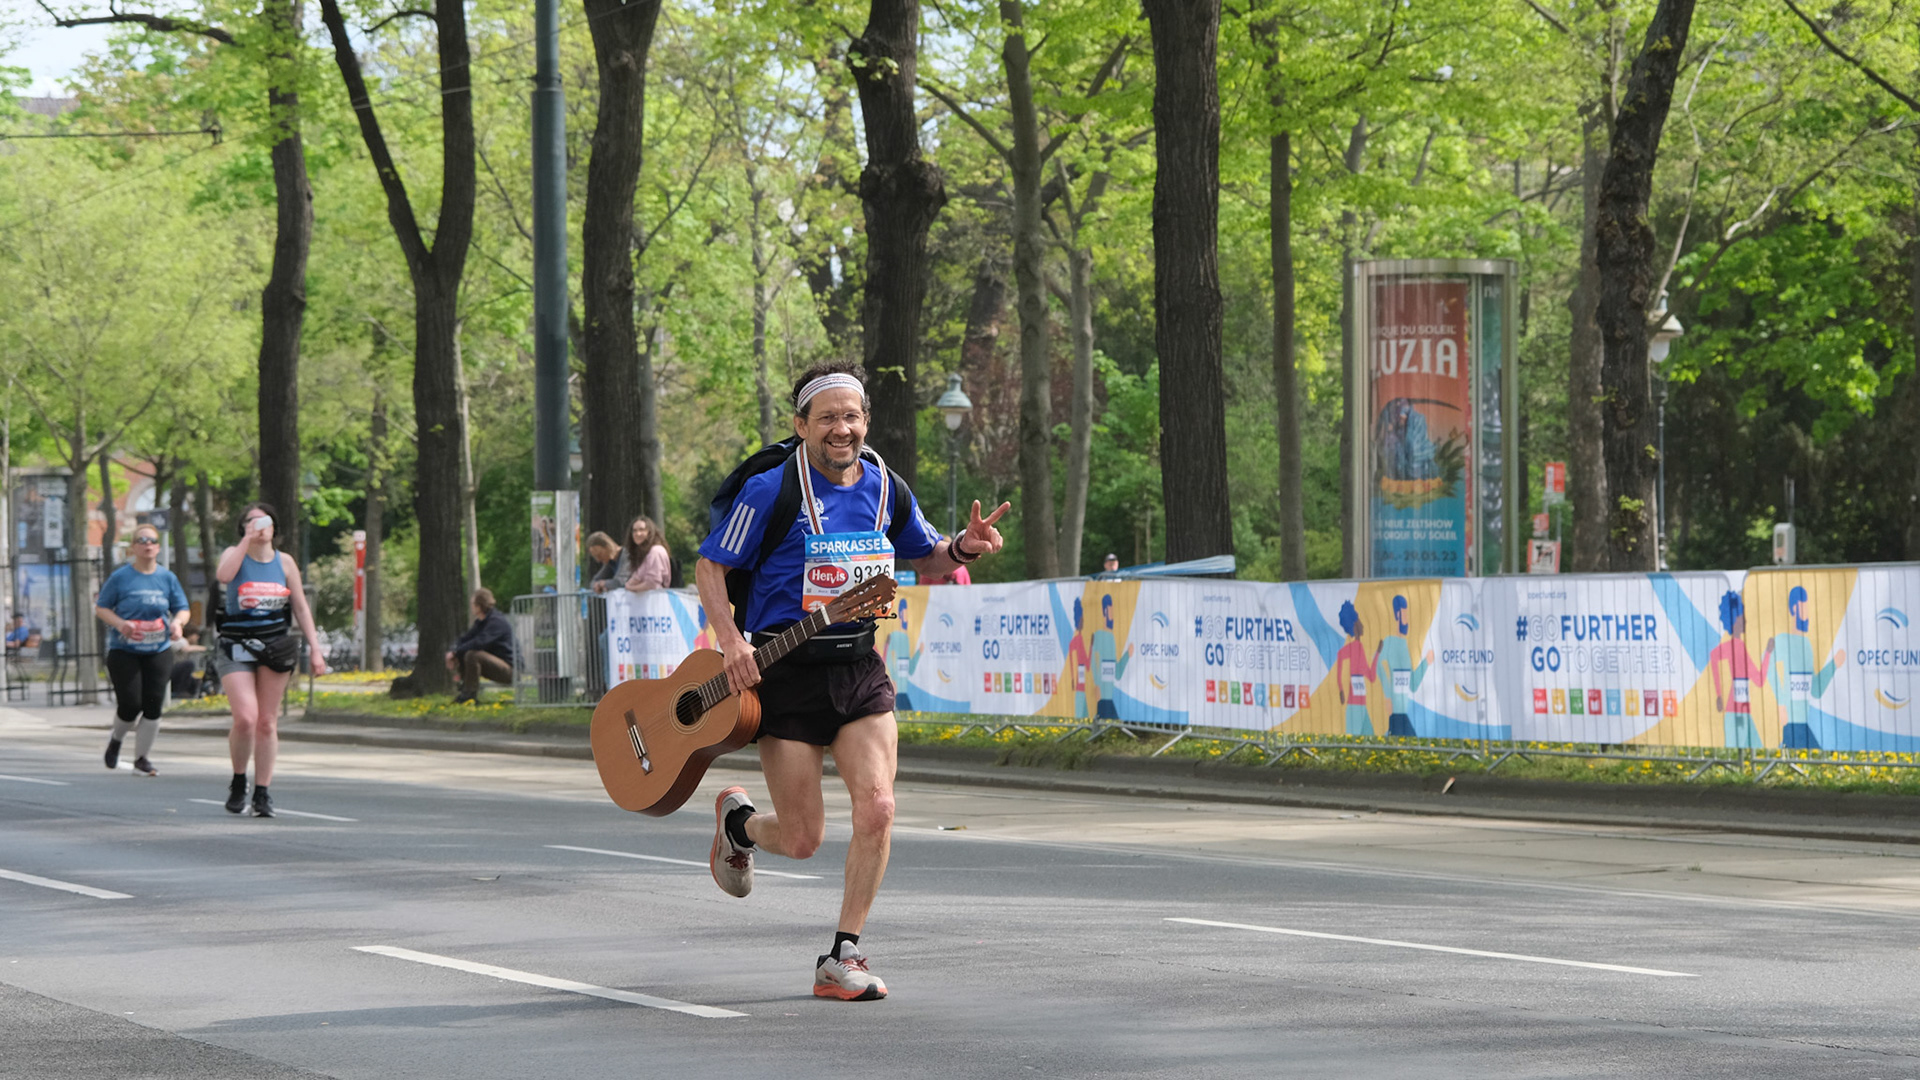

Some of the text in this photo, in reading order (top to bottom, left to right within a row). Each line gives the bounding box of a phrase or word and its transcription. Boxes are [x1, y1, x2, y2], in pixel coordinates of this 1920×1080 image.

[1401, 325, 1416, 335] DU
[1418, 324, 1457, 335] SOLEIL
[1413, 531, 1426, 540] DU
[1429, 531, 1457, 540] SOLEIL
[810, 538, 881, 555] SPARKASSE
[811, 568, 846, 584] Hervis
[1140, 643, 1179, 656] OPEC FUND
[1442, 650, 1494, 664] OPEC FUND
[1857, 650, 1920, 666] OPEC FUN
[1790, 681, 1809, 691] 2023
